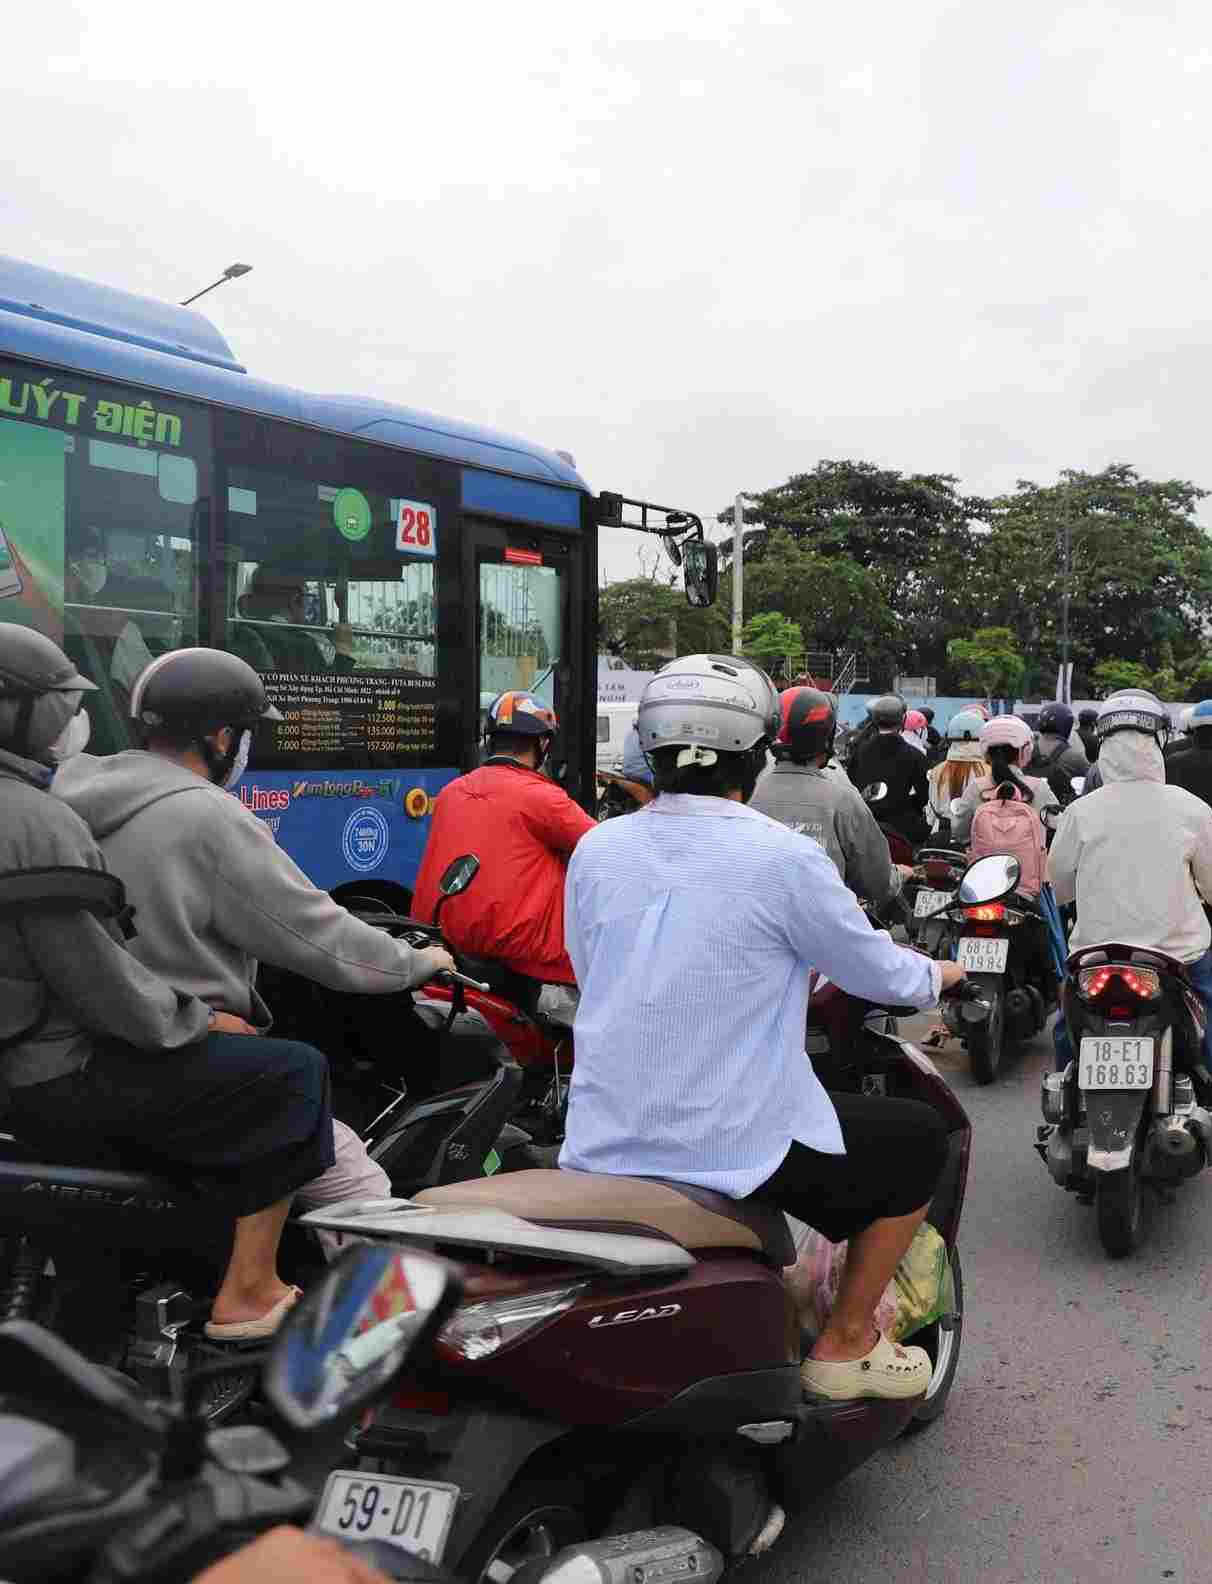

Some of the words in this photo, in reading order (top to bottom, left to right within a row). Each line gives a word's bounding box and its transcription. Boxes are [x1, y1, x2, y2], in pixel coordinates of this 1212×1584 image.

[401, 506, 431, 547] 28
[1092, 1041, 1142, 1062] 18-E1
[1086, 1064, 1148, 1085] 168.63
[587, 1303, 681, 1329] LEAD
[338, 1483, 431, 1539] 59-D1
